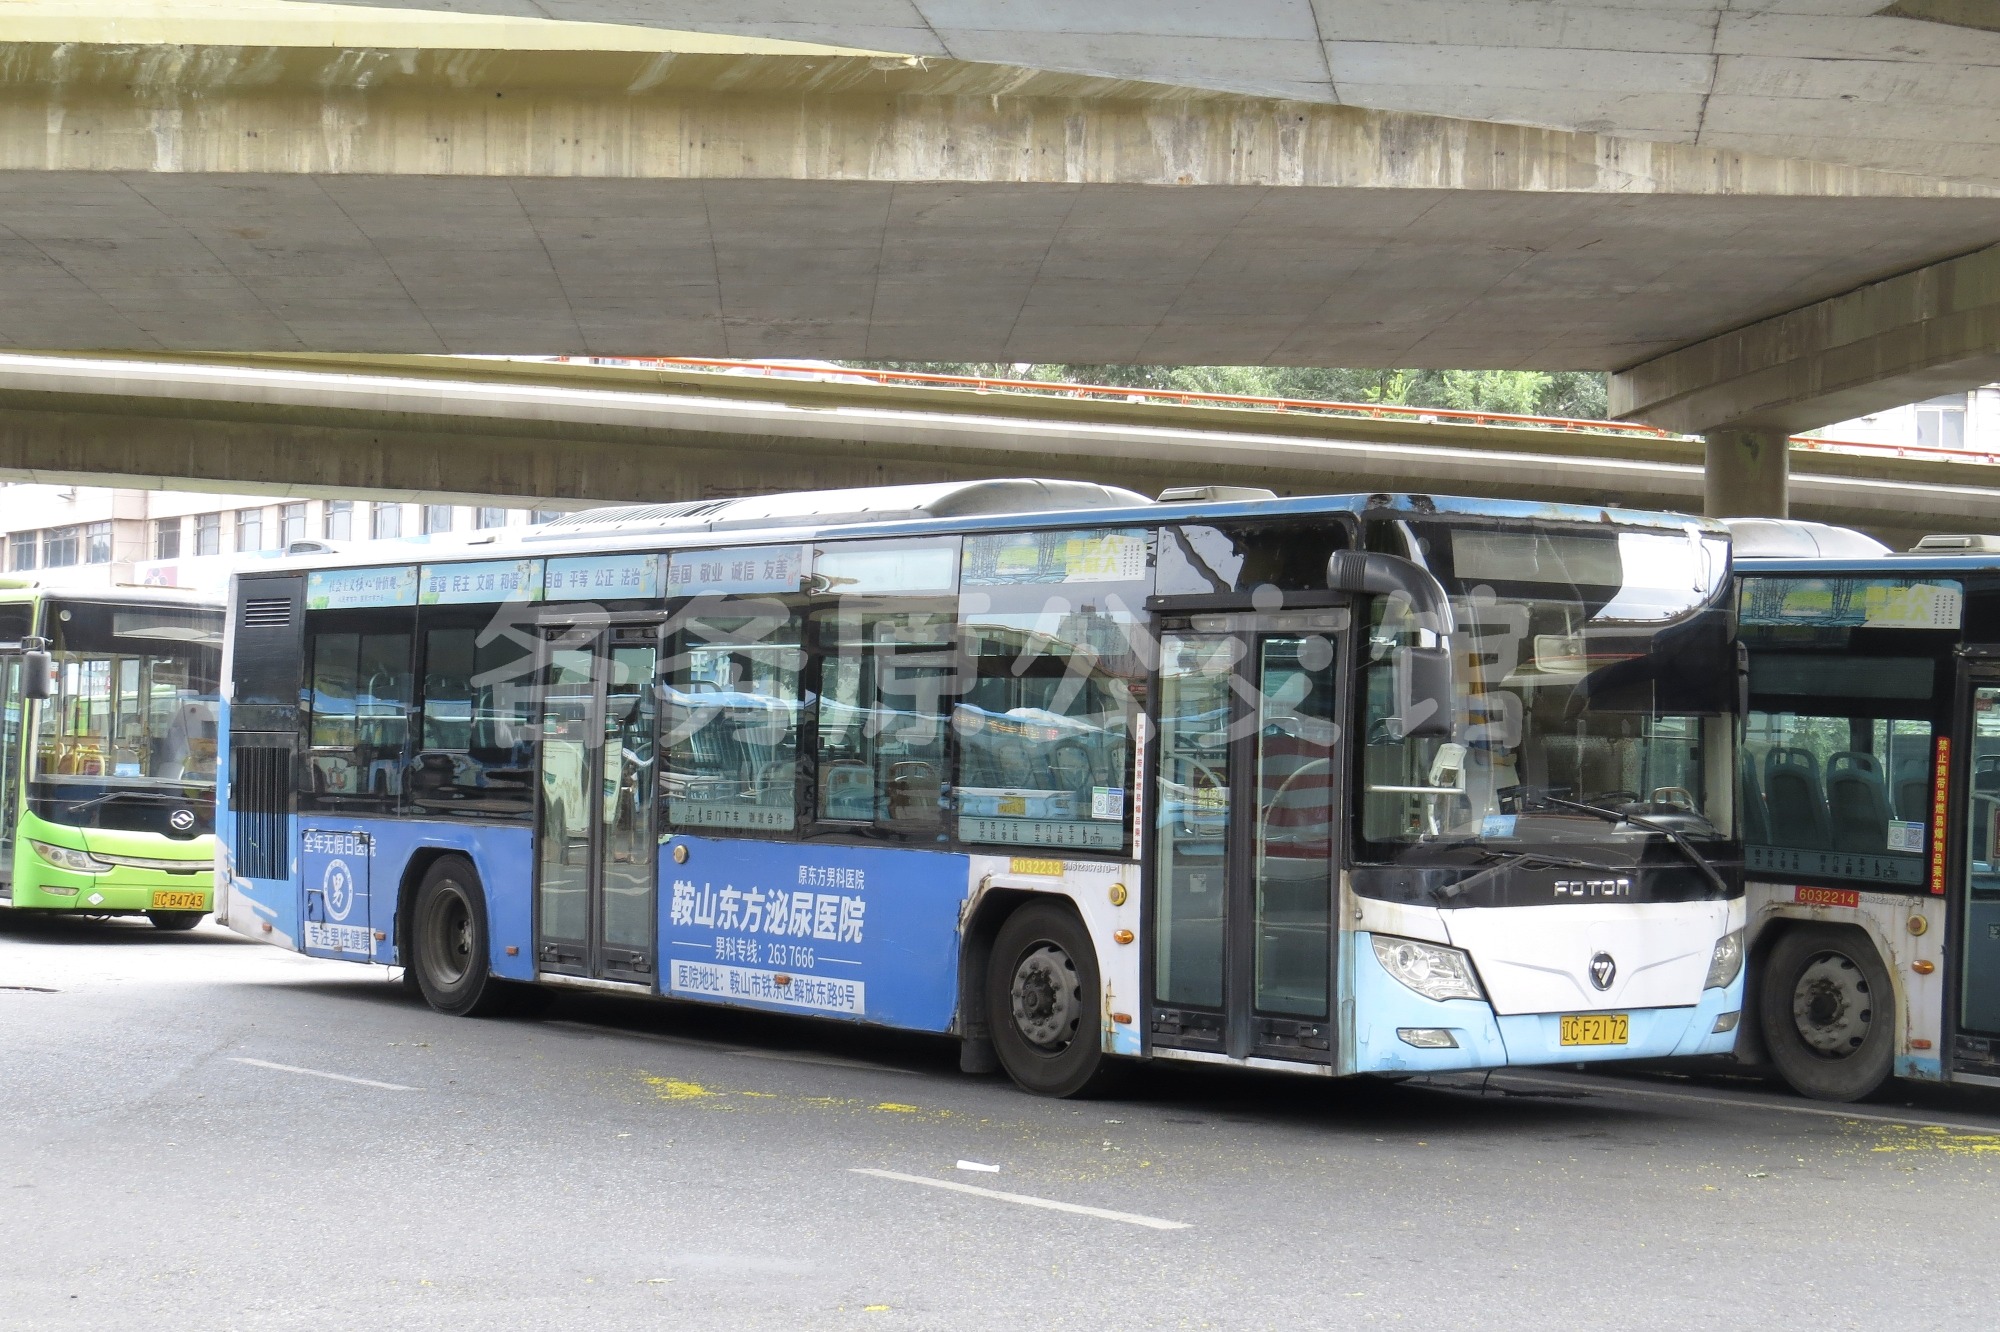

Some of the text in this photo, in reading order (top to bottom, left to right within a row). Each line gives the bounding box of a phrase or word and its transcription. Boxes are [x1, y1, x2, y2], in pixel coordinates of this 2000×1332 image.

[429, 572, 519, 593] 富强 民主 文明 和谐
[545, 567, 641, 588] 自由 平等 公正 法治
[669, 559, 788, 585] 爱国 敬业 诚信 友善
[1932, 739, 1948, 889] 禁止携带易燃易爆物品乘车
[798, 865, 865, 890] 原东方男科医院
[1012, 859, 1061, 875] 6032233
[1554, 879, 1629, 896] FOTON
[1799, 888, 1855, 905] 6032214
[670, 880, 866, 944] 鞍山东方泌尿医院
[309, 925, 370, 952] 专注男性健康
